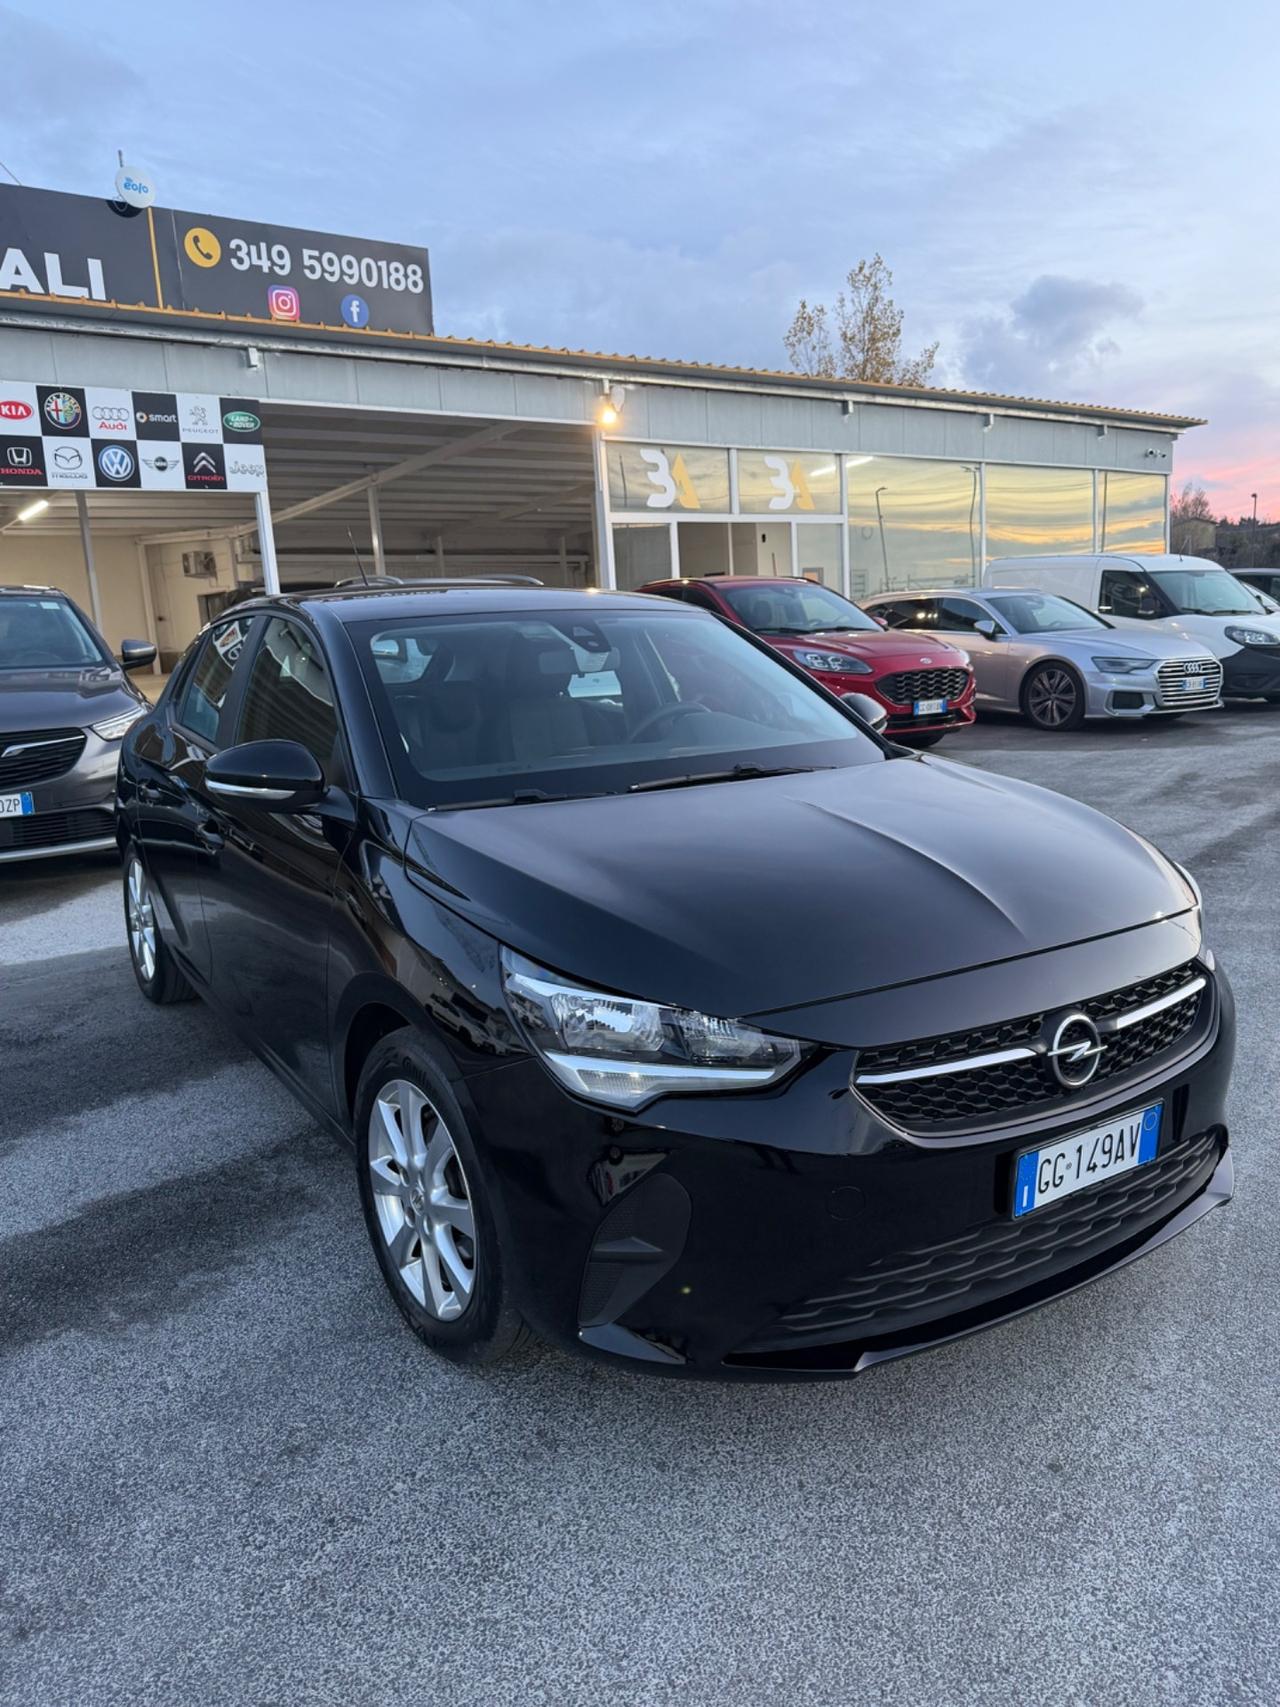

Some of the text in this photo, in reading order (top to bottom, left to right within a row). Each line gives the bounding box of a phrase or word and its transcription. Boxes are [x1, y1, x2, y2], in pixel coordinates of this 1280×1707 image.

[229, 238, 424, 294] 349 5990188
[0, 247, 107, 301] ALI
[148, 413, 177, 423] smart
[98, 421, 128, 431] Audi
[0, 467, 42, 475] HONDA
